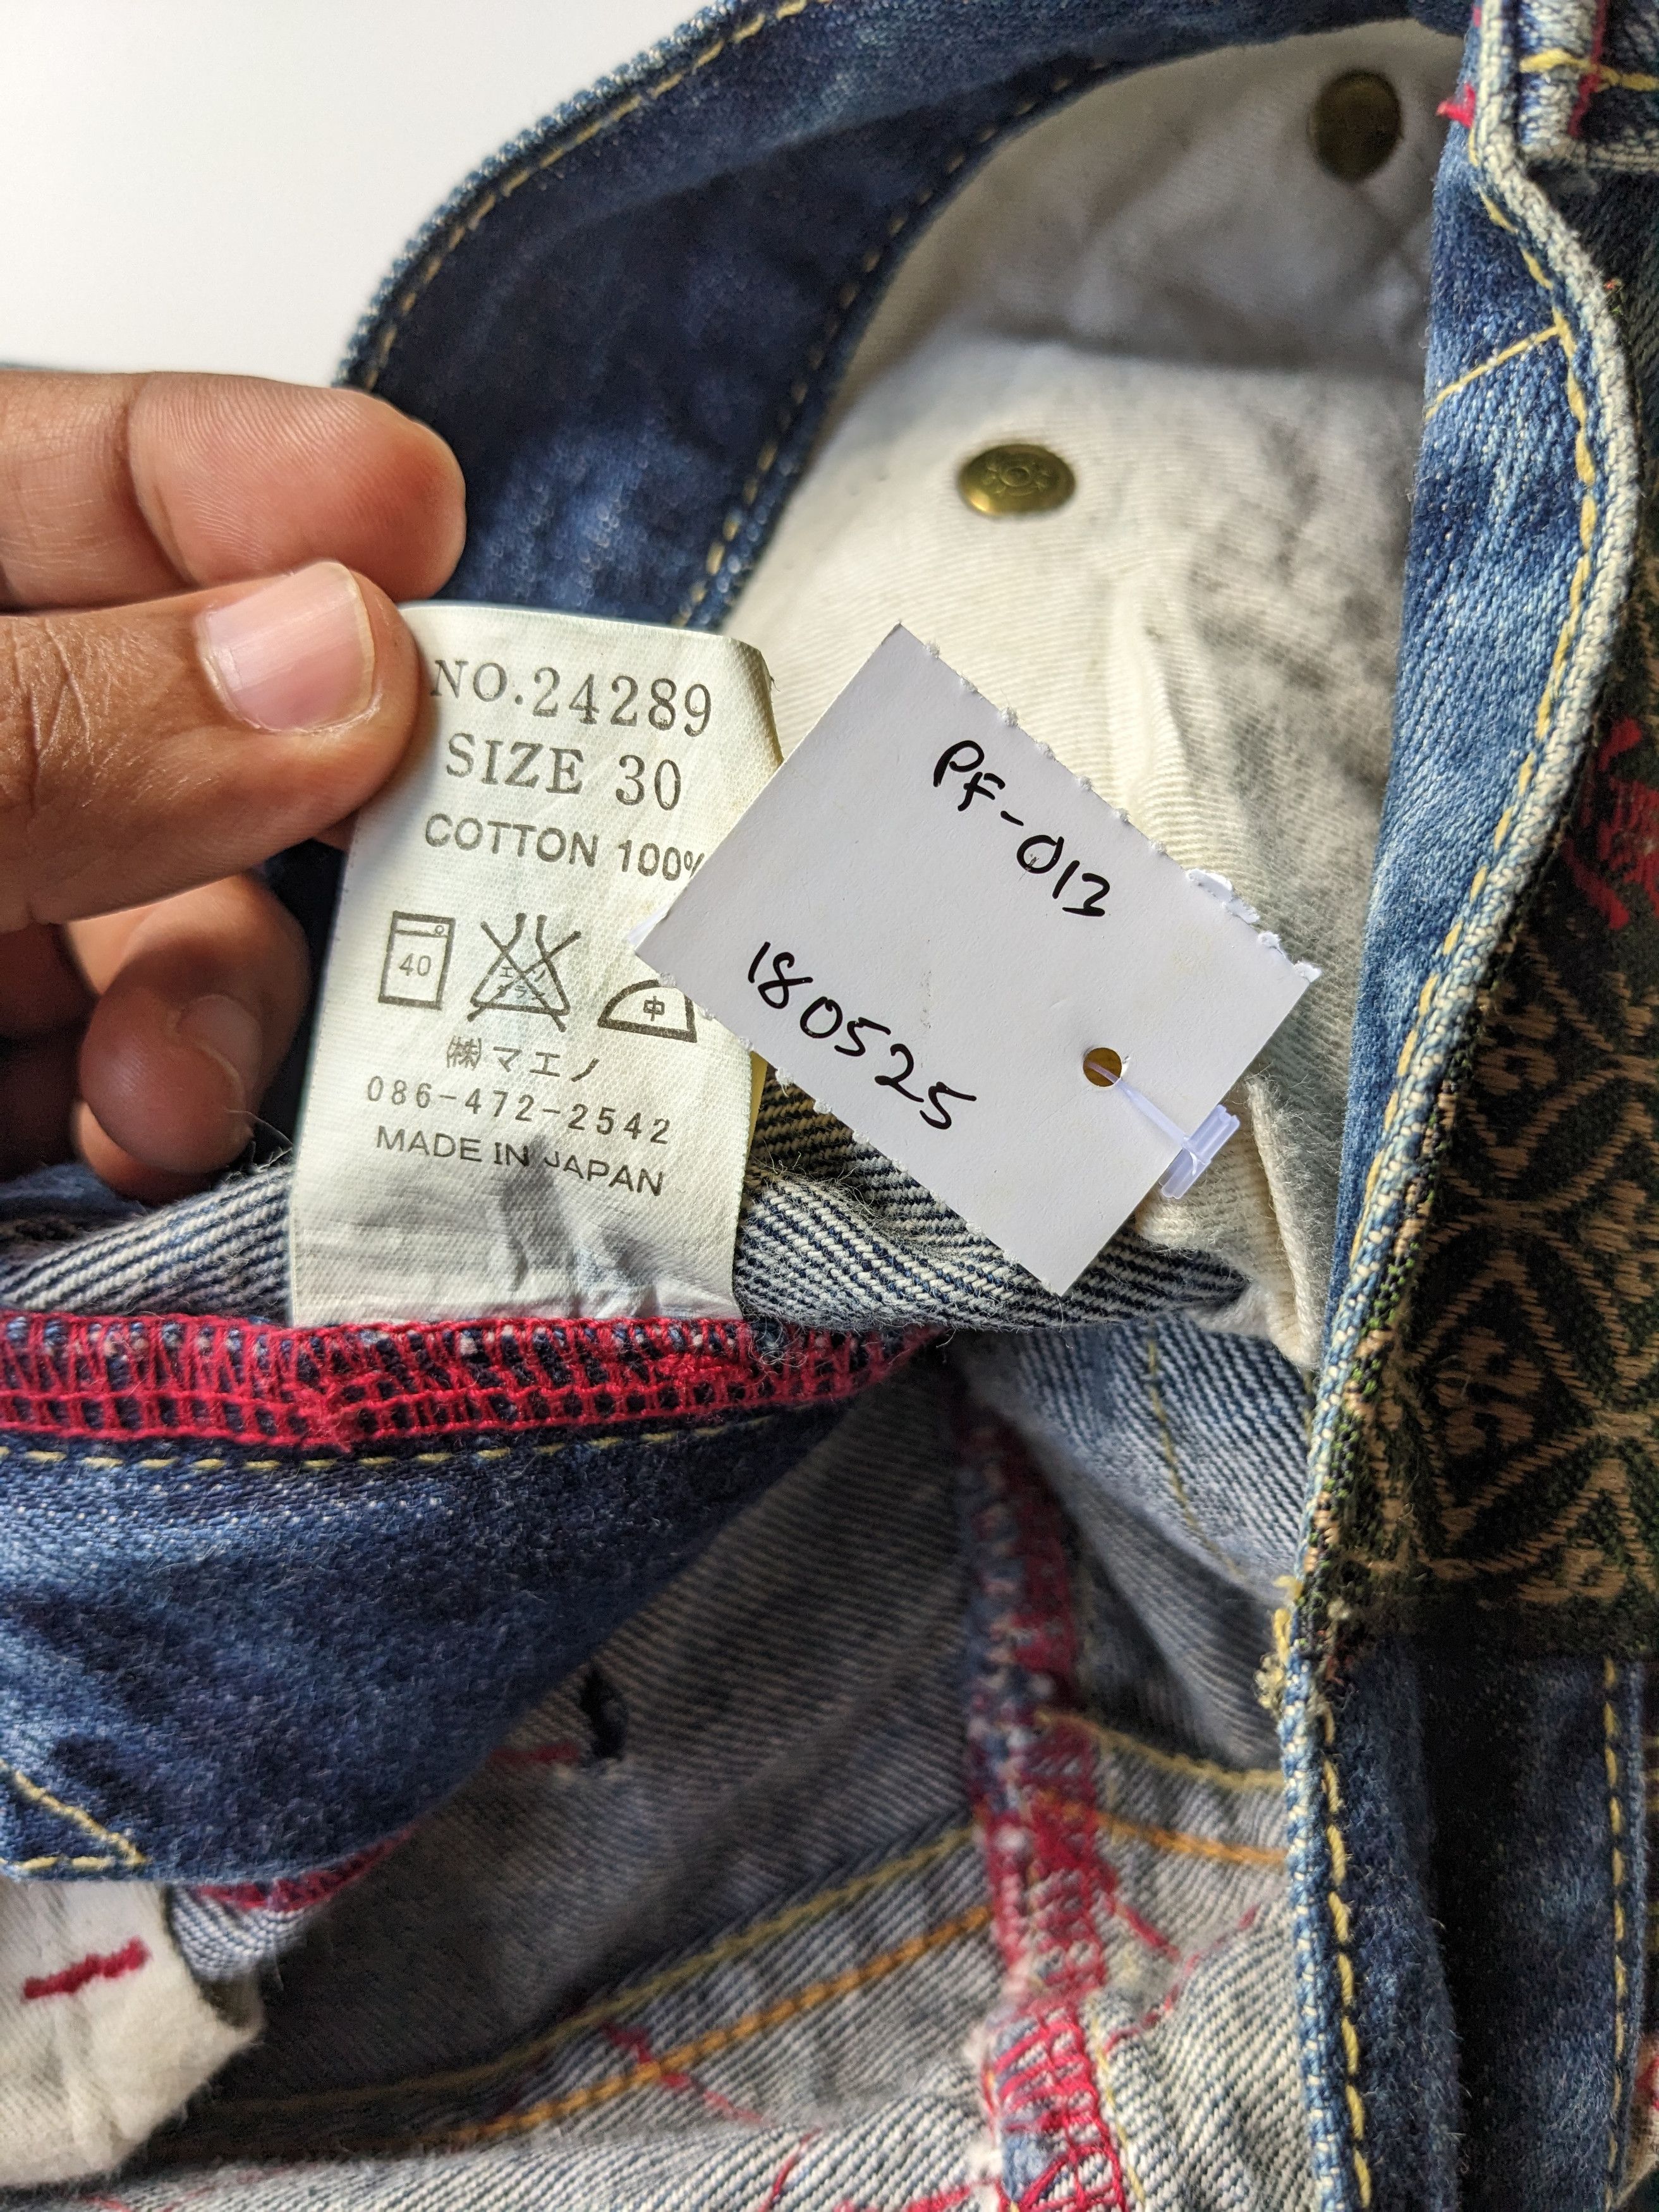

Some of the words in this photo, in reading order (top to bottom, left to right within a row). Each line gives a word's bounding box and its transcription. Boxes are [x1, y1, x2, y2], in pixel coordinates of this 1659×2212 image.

[430, 659, 712, 738] NO.24289
[446, 732, 584, 794] SIZE
[616, 755, 681, 811] 30
[425, 813, 599, 868] COTTON
[399, 953, 432, 977] 40
[643, 995, 665, 1022] 中
[748, 941, 977, 1130] 180525
[368, 1075, 671, 1145] 086-472-2542
[377, 1126, 483, 1162] MADE
[494, 1141, 530, 1167] IN
[544, 1151, 664, 1196] JAPAN
